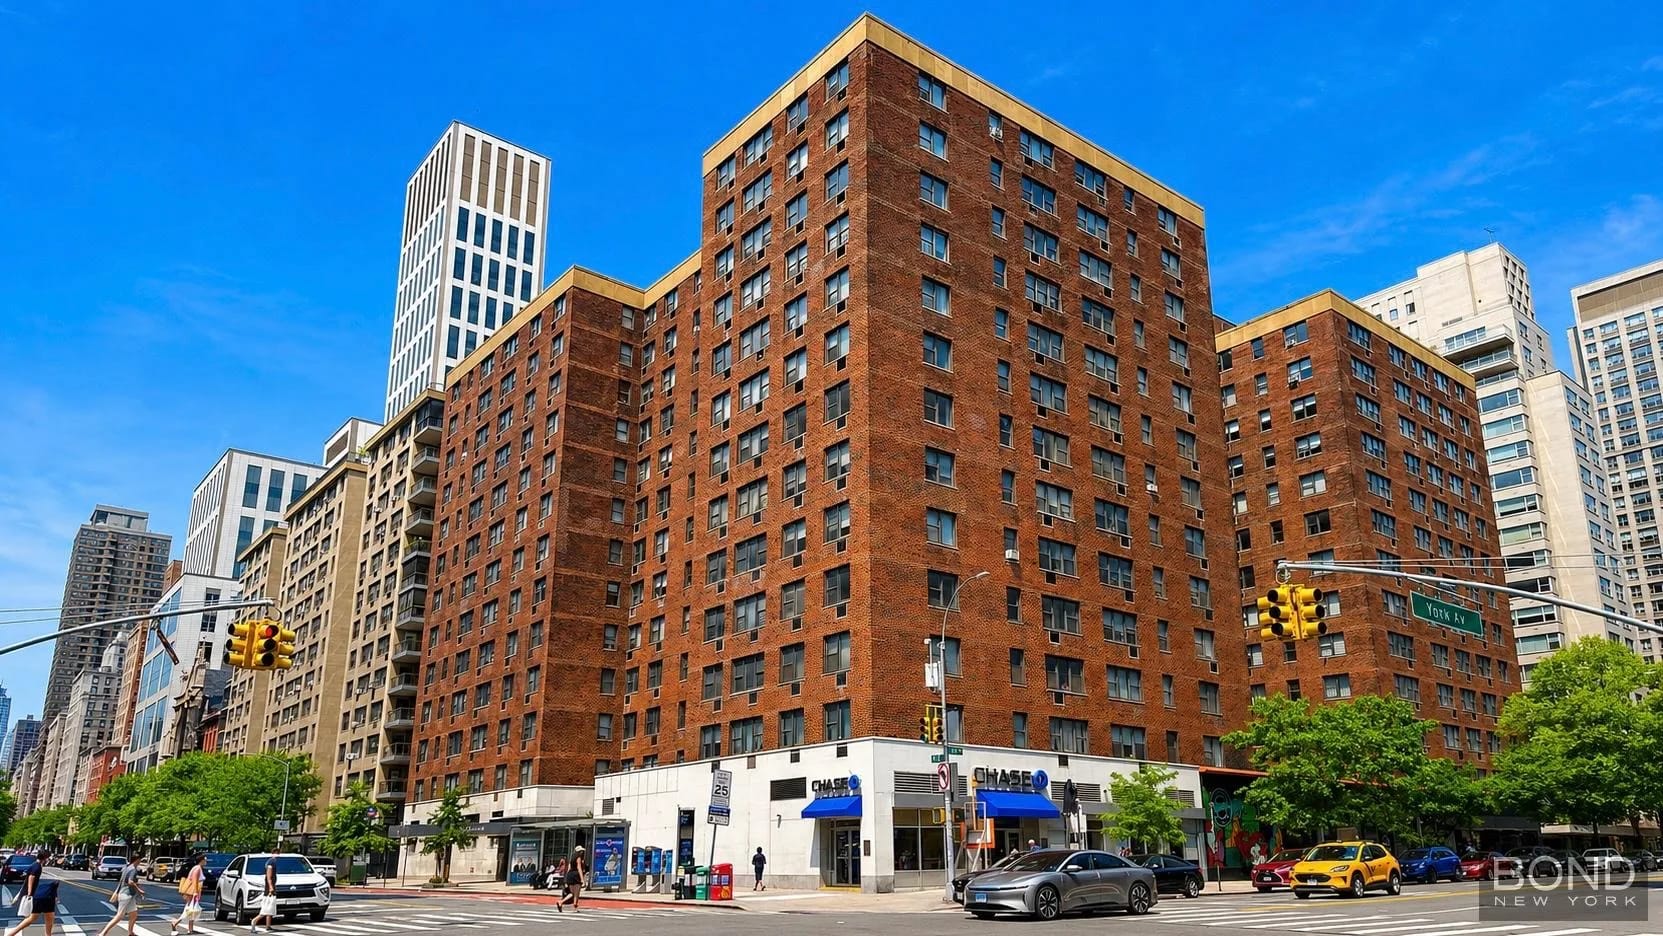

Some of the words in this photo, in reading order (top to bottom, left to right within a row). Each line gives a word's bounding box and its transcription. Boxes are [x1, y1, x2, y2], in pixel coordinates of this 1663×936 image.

[1426, 602, 1450, 621] York
[1454, 612, 1465, 625] Av
[812, 777, 849, 792] CHASE
[974, 767, 1032, 787] CHASE
[714, 784, 729, 796] 25
